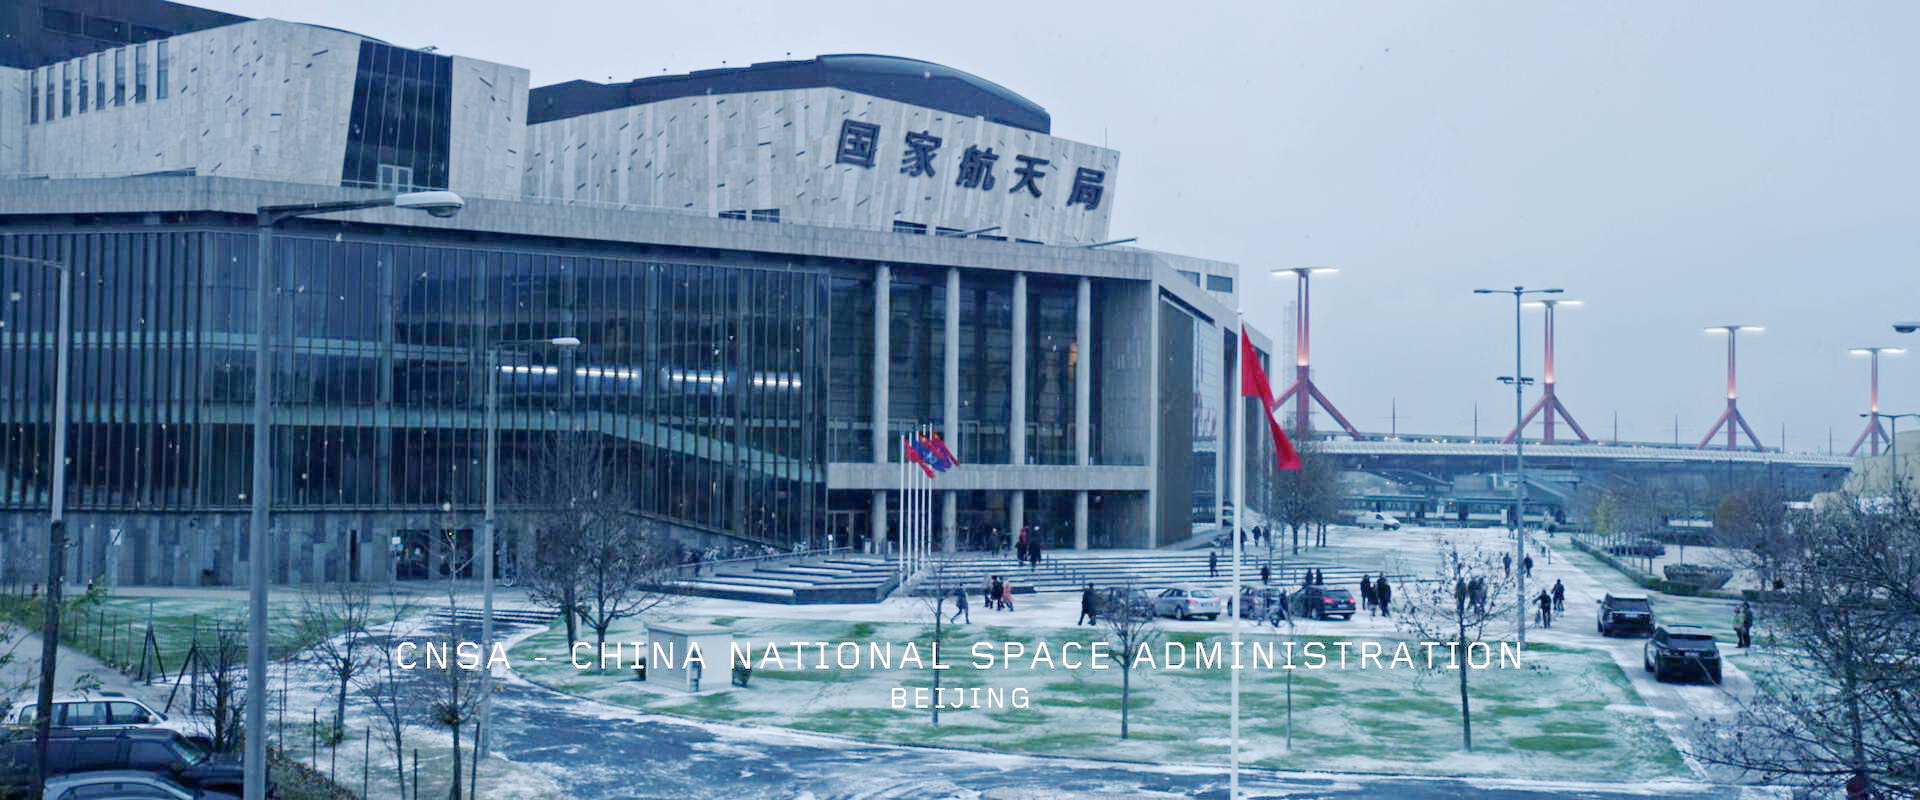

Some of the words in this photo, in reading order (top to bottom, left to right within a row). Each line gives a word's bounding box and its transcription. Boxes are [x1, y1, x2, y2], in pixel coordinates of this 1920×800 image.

[835, 119, 1106, 211] 国家航天局
